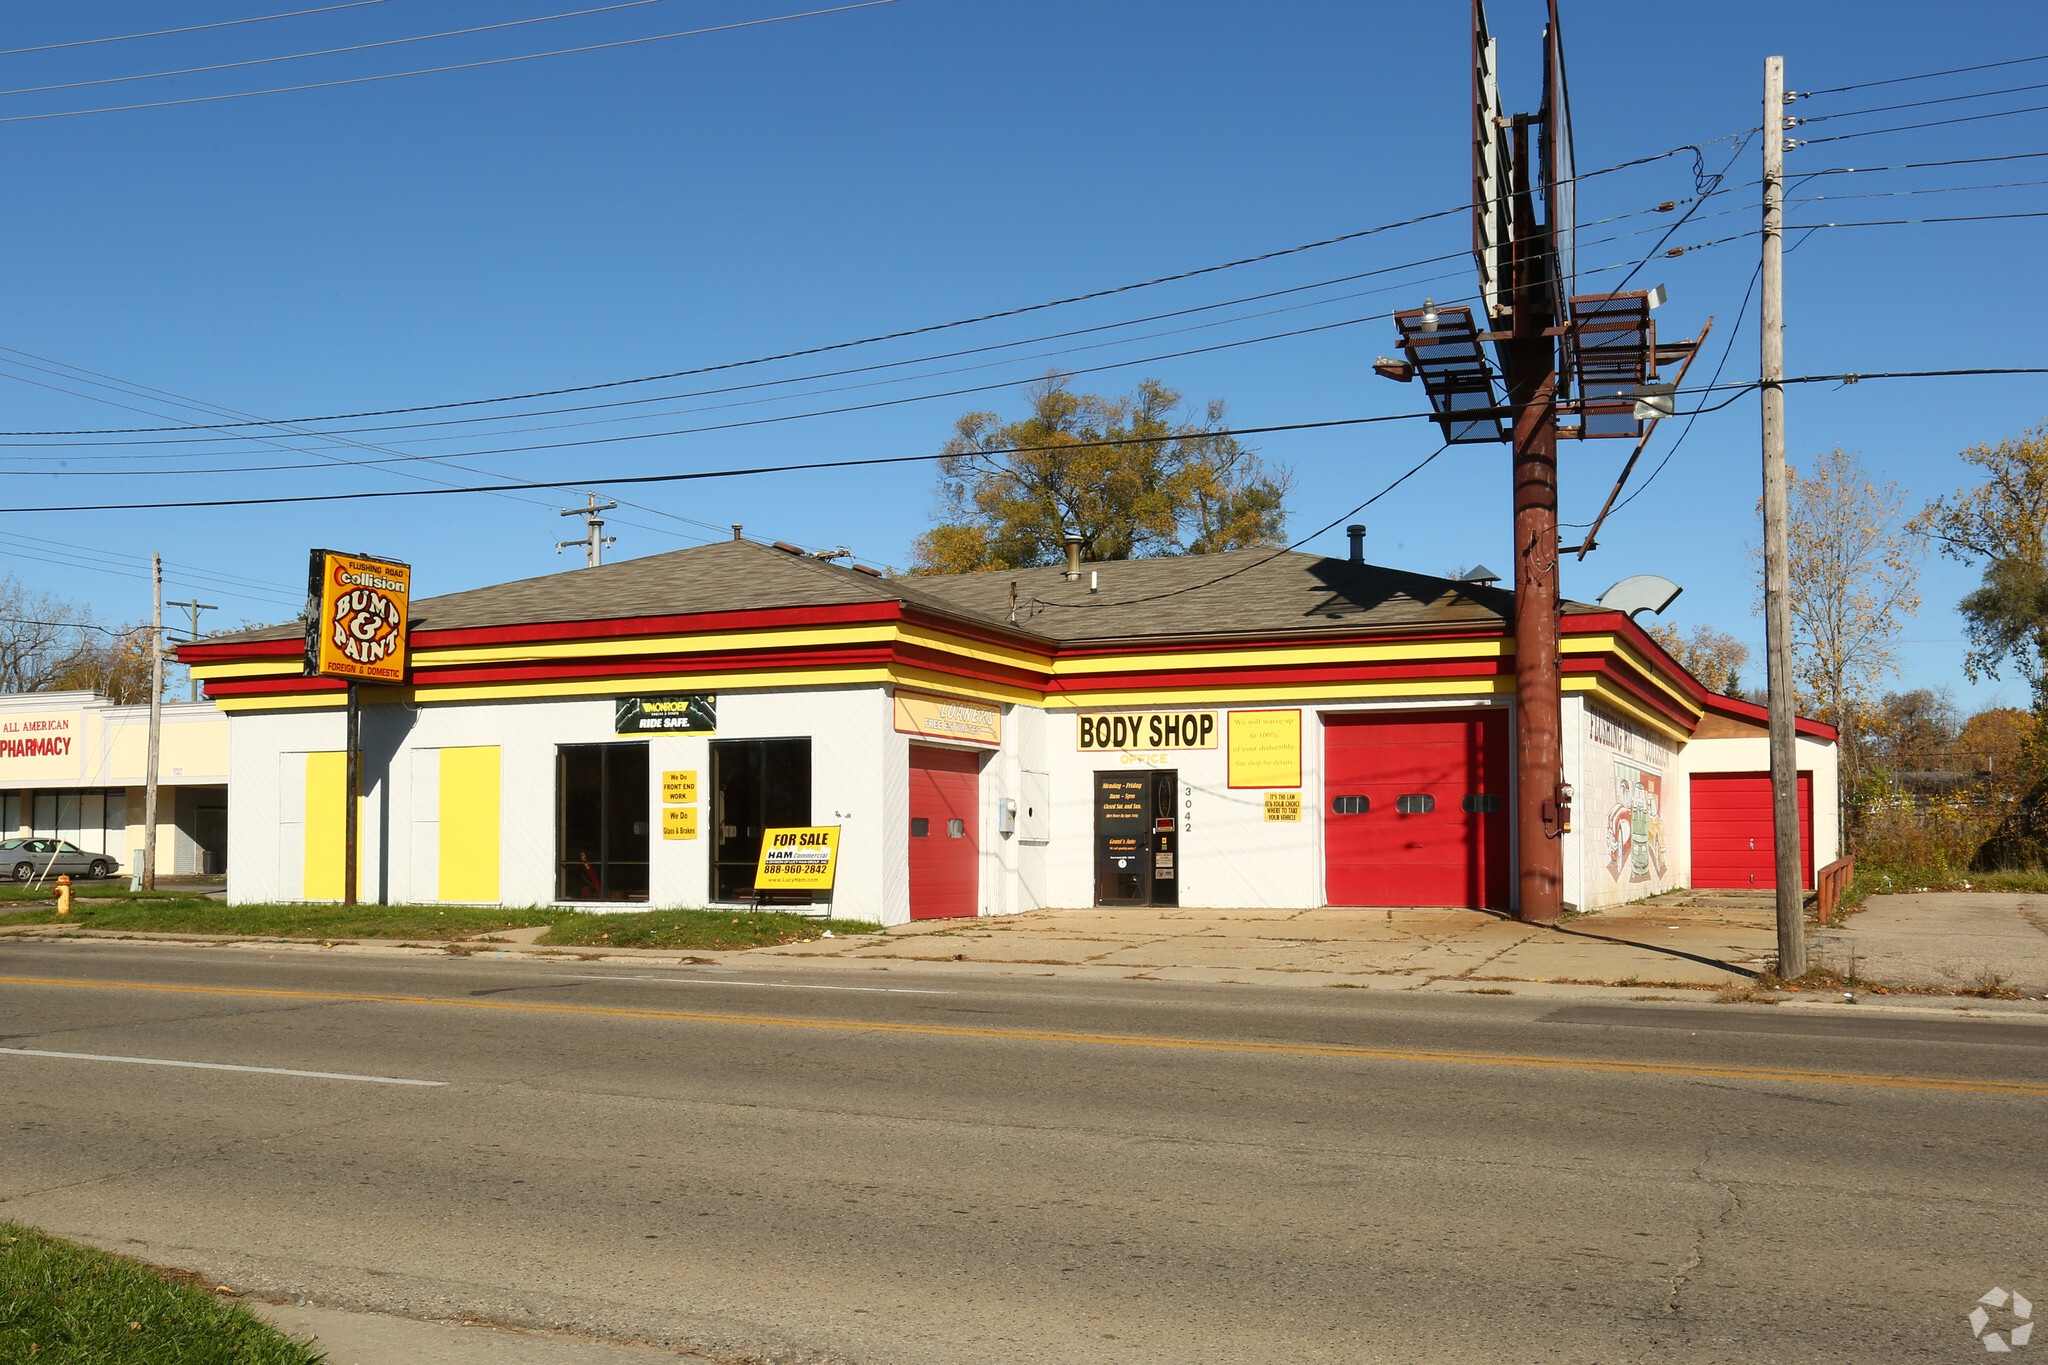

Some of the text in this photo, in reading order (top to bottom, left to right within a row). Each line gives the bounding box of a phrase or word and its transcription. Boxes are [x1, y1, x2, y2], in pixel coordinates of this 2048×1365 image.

[349, 562, 404, 577] FLUSHING ROAD
[335, 590, 399, 627] BUMP
[350, 612, 382, 640] &
[334, 621, 398, 662] PAINT
[328, 662, 356, 673] FOREIGN
[367, 667, 400, 678] DOMESTIC
[642, 702, 689, 712] MONROE
[940, 702, 995, 725] LOANERS
[3, 720, 69, 732] ALL AMERICAN
[639, 718, 690, 728] RIDE SAFE.
[925, 718, 980, 735] FREE ESTIMATES
[1080, 714, 1213, 748] BODY SHOP
[0, 737, 71, 757] PHARMACY
[1120, 754, 1168, 764] OFFICE
[773, 833, 828, 846] FOR SALE
[768, 851, 793, 859] HAM
[764, 865, 827, 874] 888-960-2842
